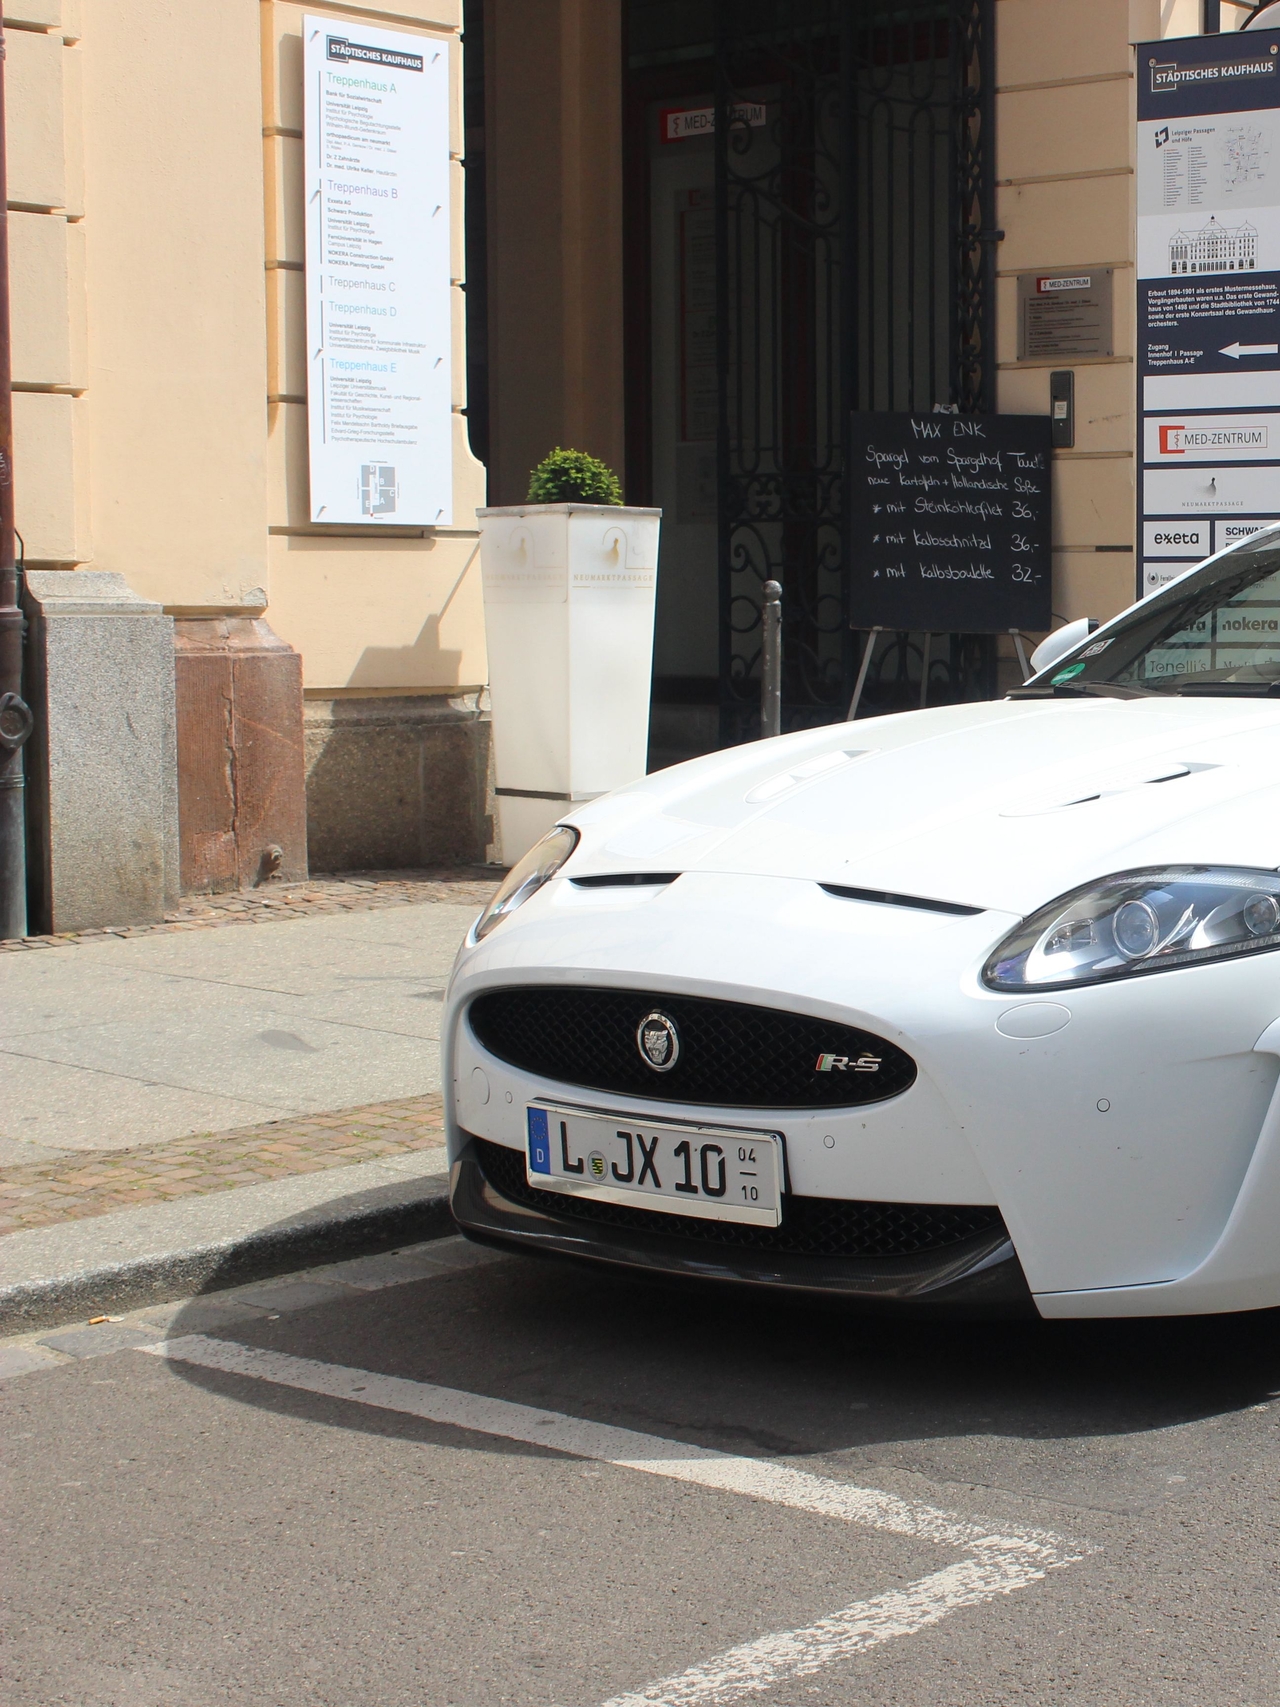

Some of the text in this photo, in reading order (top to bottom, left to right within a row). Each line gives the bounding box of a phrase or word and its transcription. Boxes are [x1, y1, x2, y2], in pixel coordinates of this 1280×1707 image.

[331, 44, 422, 68] STÄDTISCHES KAUFHAUS
[1156, 62, 1274, 84] STÄDTISCHES KAUFHAUS
[327, 72, 397, 93] Treppenhaus A
[328, 180, 399, 199] Treppenhaus B
[329, 276, 396, 292] Treppenhaus C
[1049, 279, 1090, 289] MED-ZENTRUM
[1224, 284, 1277, 292] Mustermessehaus.
[1148, 296, 1195, 305] Vorgängerbauten
[1210, 300, 1253, 309] Stadtbibliothek
[329, 301, 397, 317] Treppenhaus D
[1236, 307, 1276, 316] Gewandhaus-
[1180, 350, 1204, 358] Passage
[330, 358, 397, 373] Treppenhaus E
[1148, 358, 1184, 366] Treppenhaus
[911, 418, 986, 439] MAX ENK
[1184, 432, 1262, 445] MED-ZENTRUM
[866, 444, 909, 470] Spargel
[918, 455, 939, 463] vom
[868, 476, 890, 485] neue
[886, 501, 907, 513] mit
[886, 533, 907, 544] mit
[573, 574, 653, 582] NEUMARKTPASSAGE
[886, 563, 907, 578] mit
[1222, 617, 1279, 631] nokera
[536, 1148, 545, 1163] D
[560, 1121, 727, 1198] L JX 10
[738, 1146, 756, 1163] 04
[741, 1185, 758, 1201] 10
